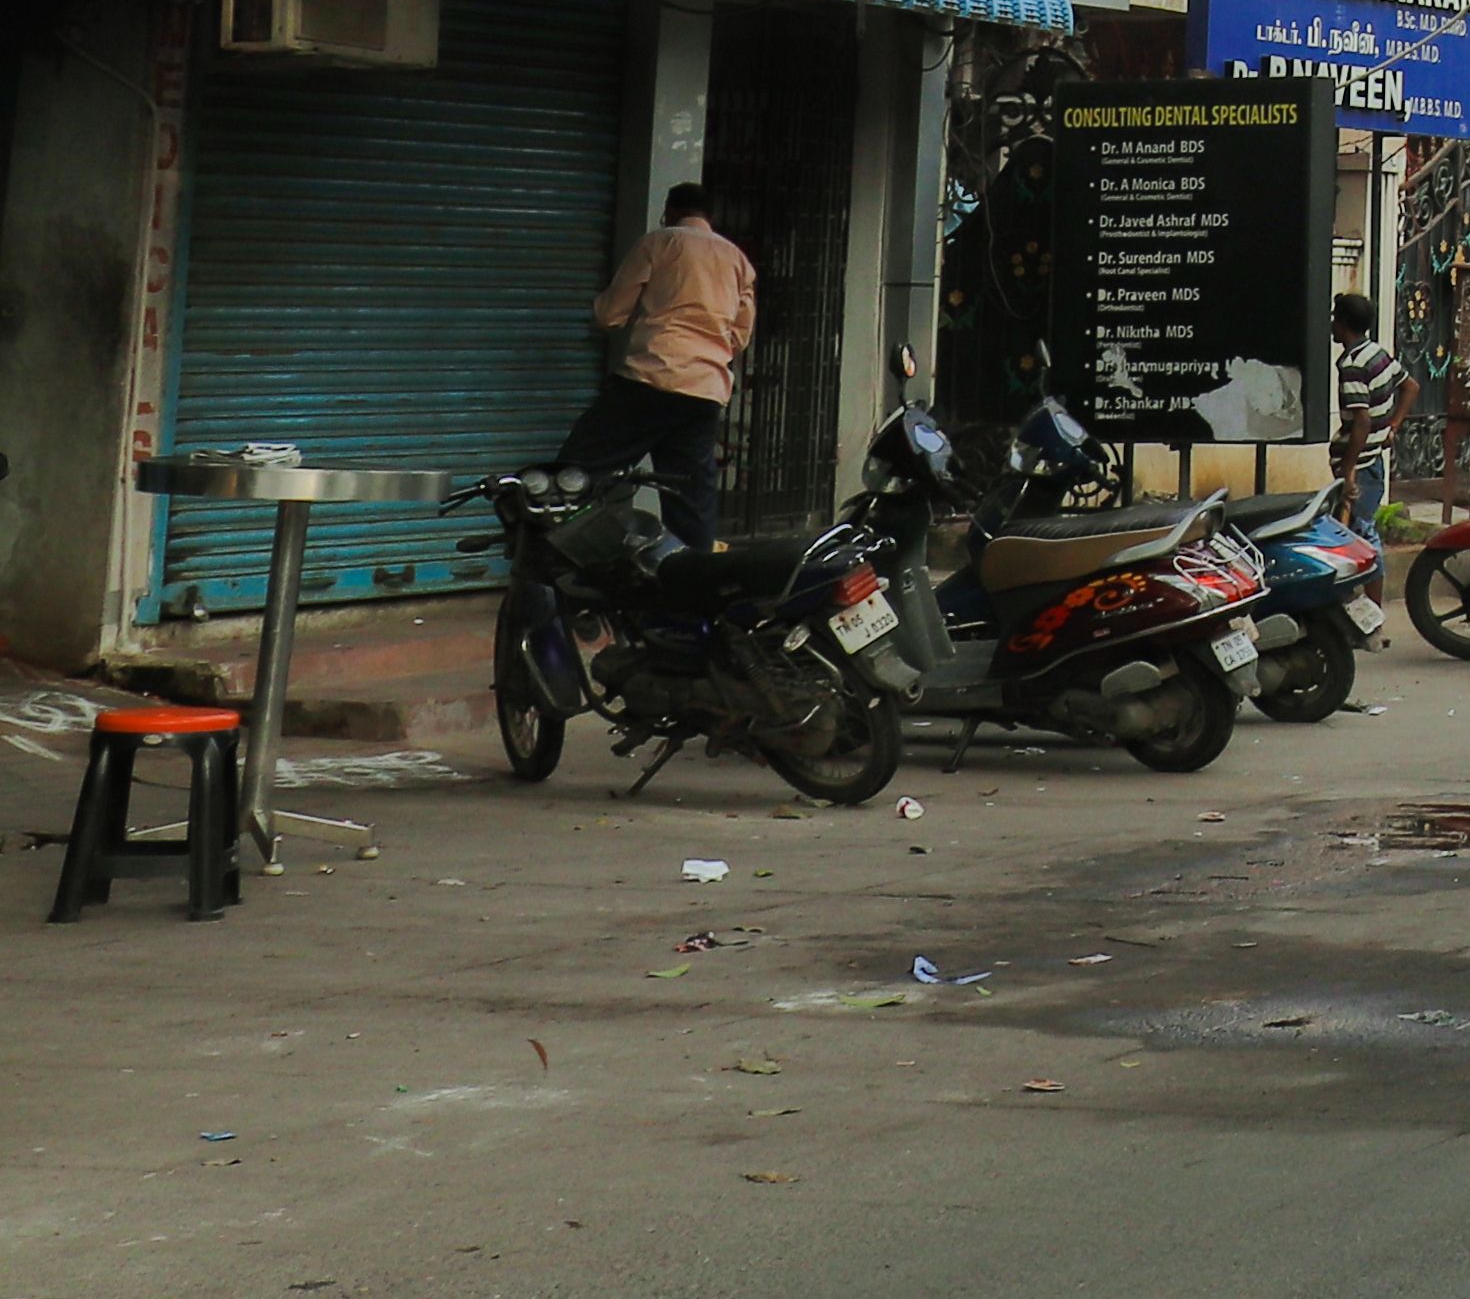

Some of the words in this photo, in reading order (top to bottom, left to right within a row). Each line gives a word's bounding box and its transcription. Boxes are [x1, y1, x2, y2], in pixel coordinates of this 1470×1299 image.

[1064, 107, 1151, 129] CONSULTING
[1155, 106, 1209, 127] DENTAL
[1211, 104, 1298, 126] SPECIALISTS
[1102, 142, 1119, 154] Dr.
[1122, 141, 1133, 153] M
[1136, 140, 1175, 153] Anand
[1180, 140, 1205, 153] BDS
[1100, 178, 1118, 191] Dr.
[1121, 179, 1129, 190] A
[1132, 178, 1176, 190] Monica
[1181, 177, 1206, 190] BDS
[1099, 215, 1117, 228] Dr.
[1119, 214, 1154, 227] Javed
[1156, 214, 1196, 227] Ashraf
[1200, 213, 1229, 227] MDS
[1098, 252, 1116, 264] Dr.
[1118, 251, 1181, 264] Surendran
[1186, 251, 1215, 264] MDS
[1097, 289, 1115, 301] Dr.
[1117, 288, 1167, 301] Praveen
[1172, 288, 1200, 301] MDS
[1096, 326, 1114, 338] Dr.
[1117, 325, 1160, 338] Nikitha
[1165, 325, 1194, 338] MDS
[1095, 397, 1112, 409] Dr.
[1115, 396, 1165, 409] Shankar
